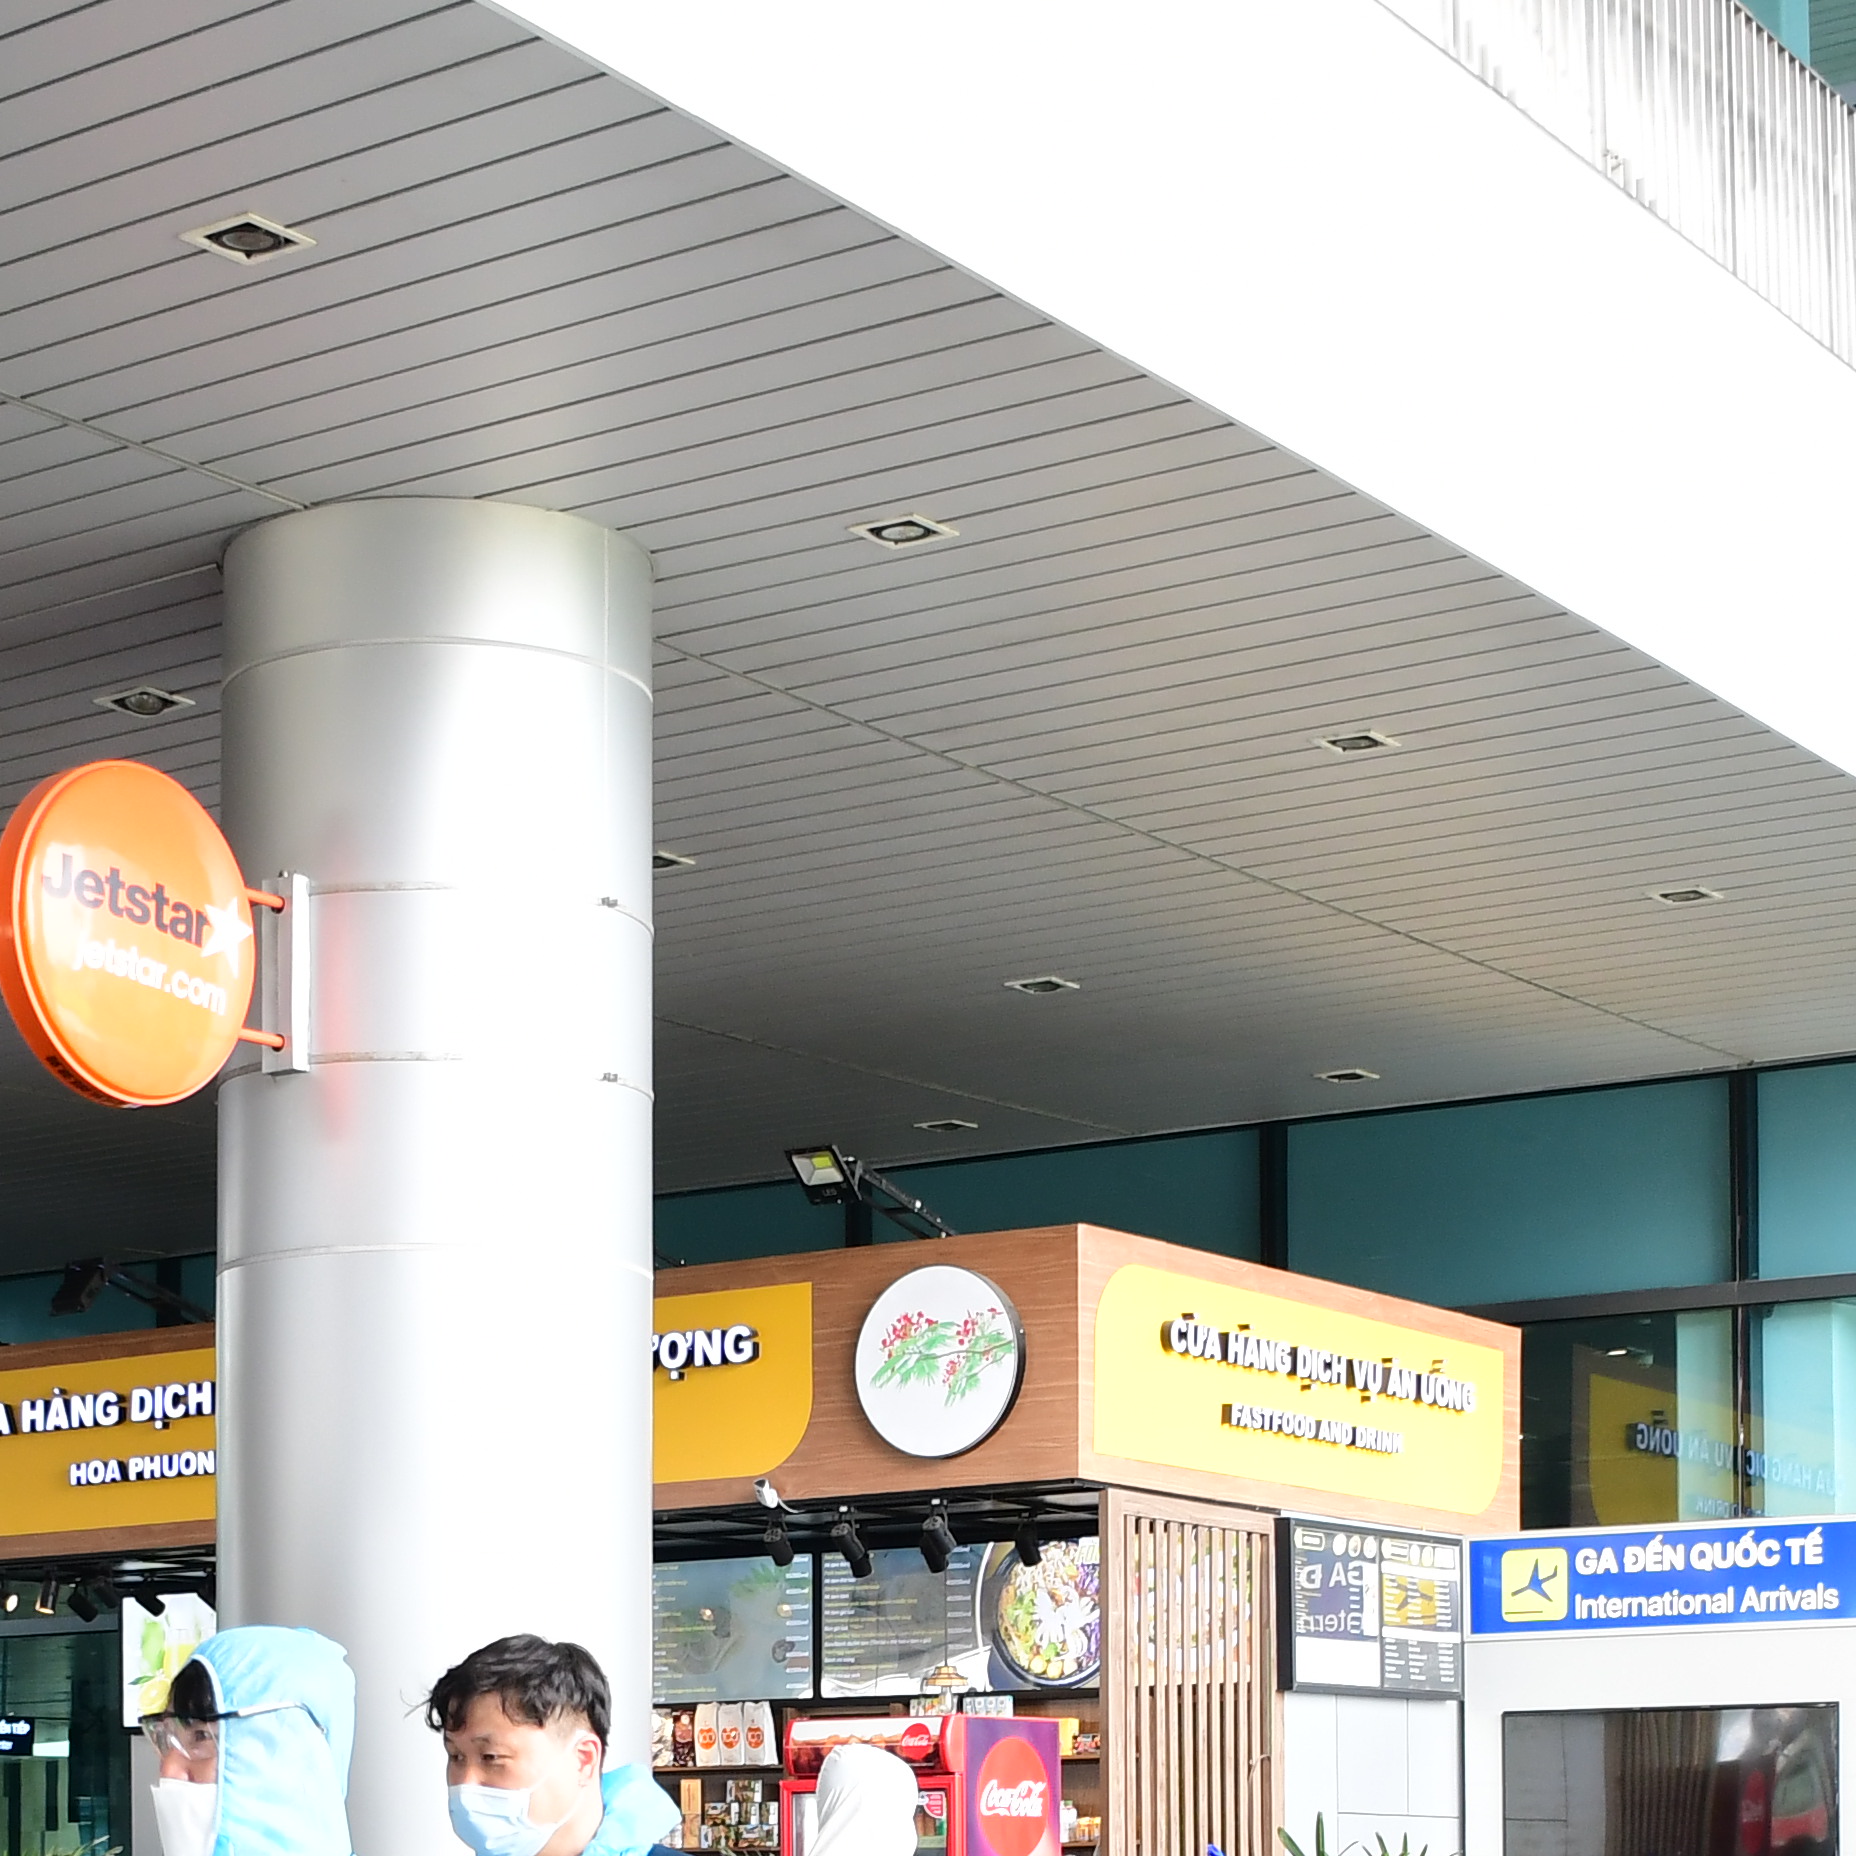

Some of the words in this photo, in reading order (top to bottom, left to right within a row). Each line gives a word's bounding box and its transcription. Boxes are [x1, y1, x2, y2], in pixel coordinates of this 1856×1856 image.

[42, 853, 208, 947] Jetstar
[72, 935, 227, 1016] jetstar.com
[21, 1386, 121, 1434] HÀNG
[131, 1380, 214, 1430] DỊCH
[1227, 1403, 1316, 1440] FASTFOOD
[1318, 1420, 1353, 1447] AND
[1355, 1426, 1406, 1454] DRINK
[68, 1459, 123, 1487] HOA
[127, 1450, 216, 1482] PHUON
[1574, 1546, 1619, 1576] GA
[1623, 1534, 1686, 1573] ĐẾN
[1689, 1529, 1781, 1571] QUỐC
[1784, 1526, 1824, 1566] TẾ
[1574, 1585, 1735, 1620] International
[1739, 1581, 1840, 1614] Arrivals
